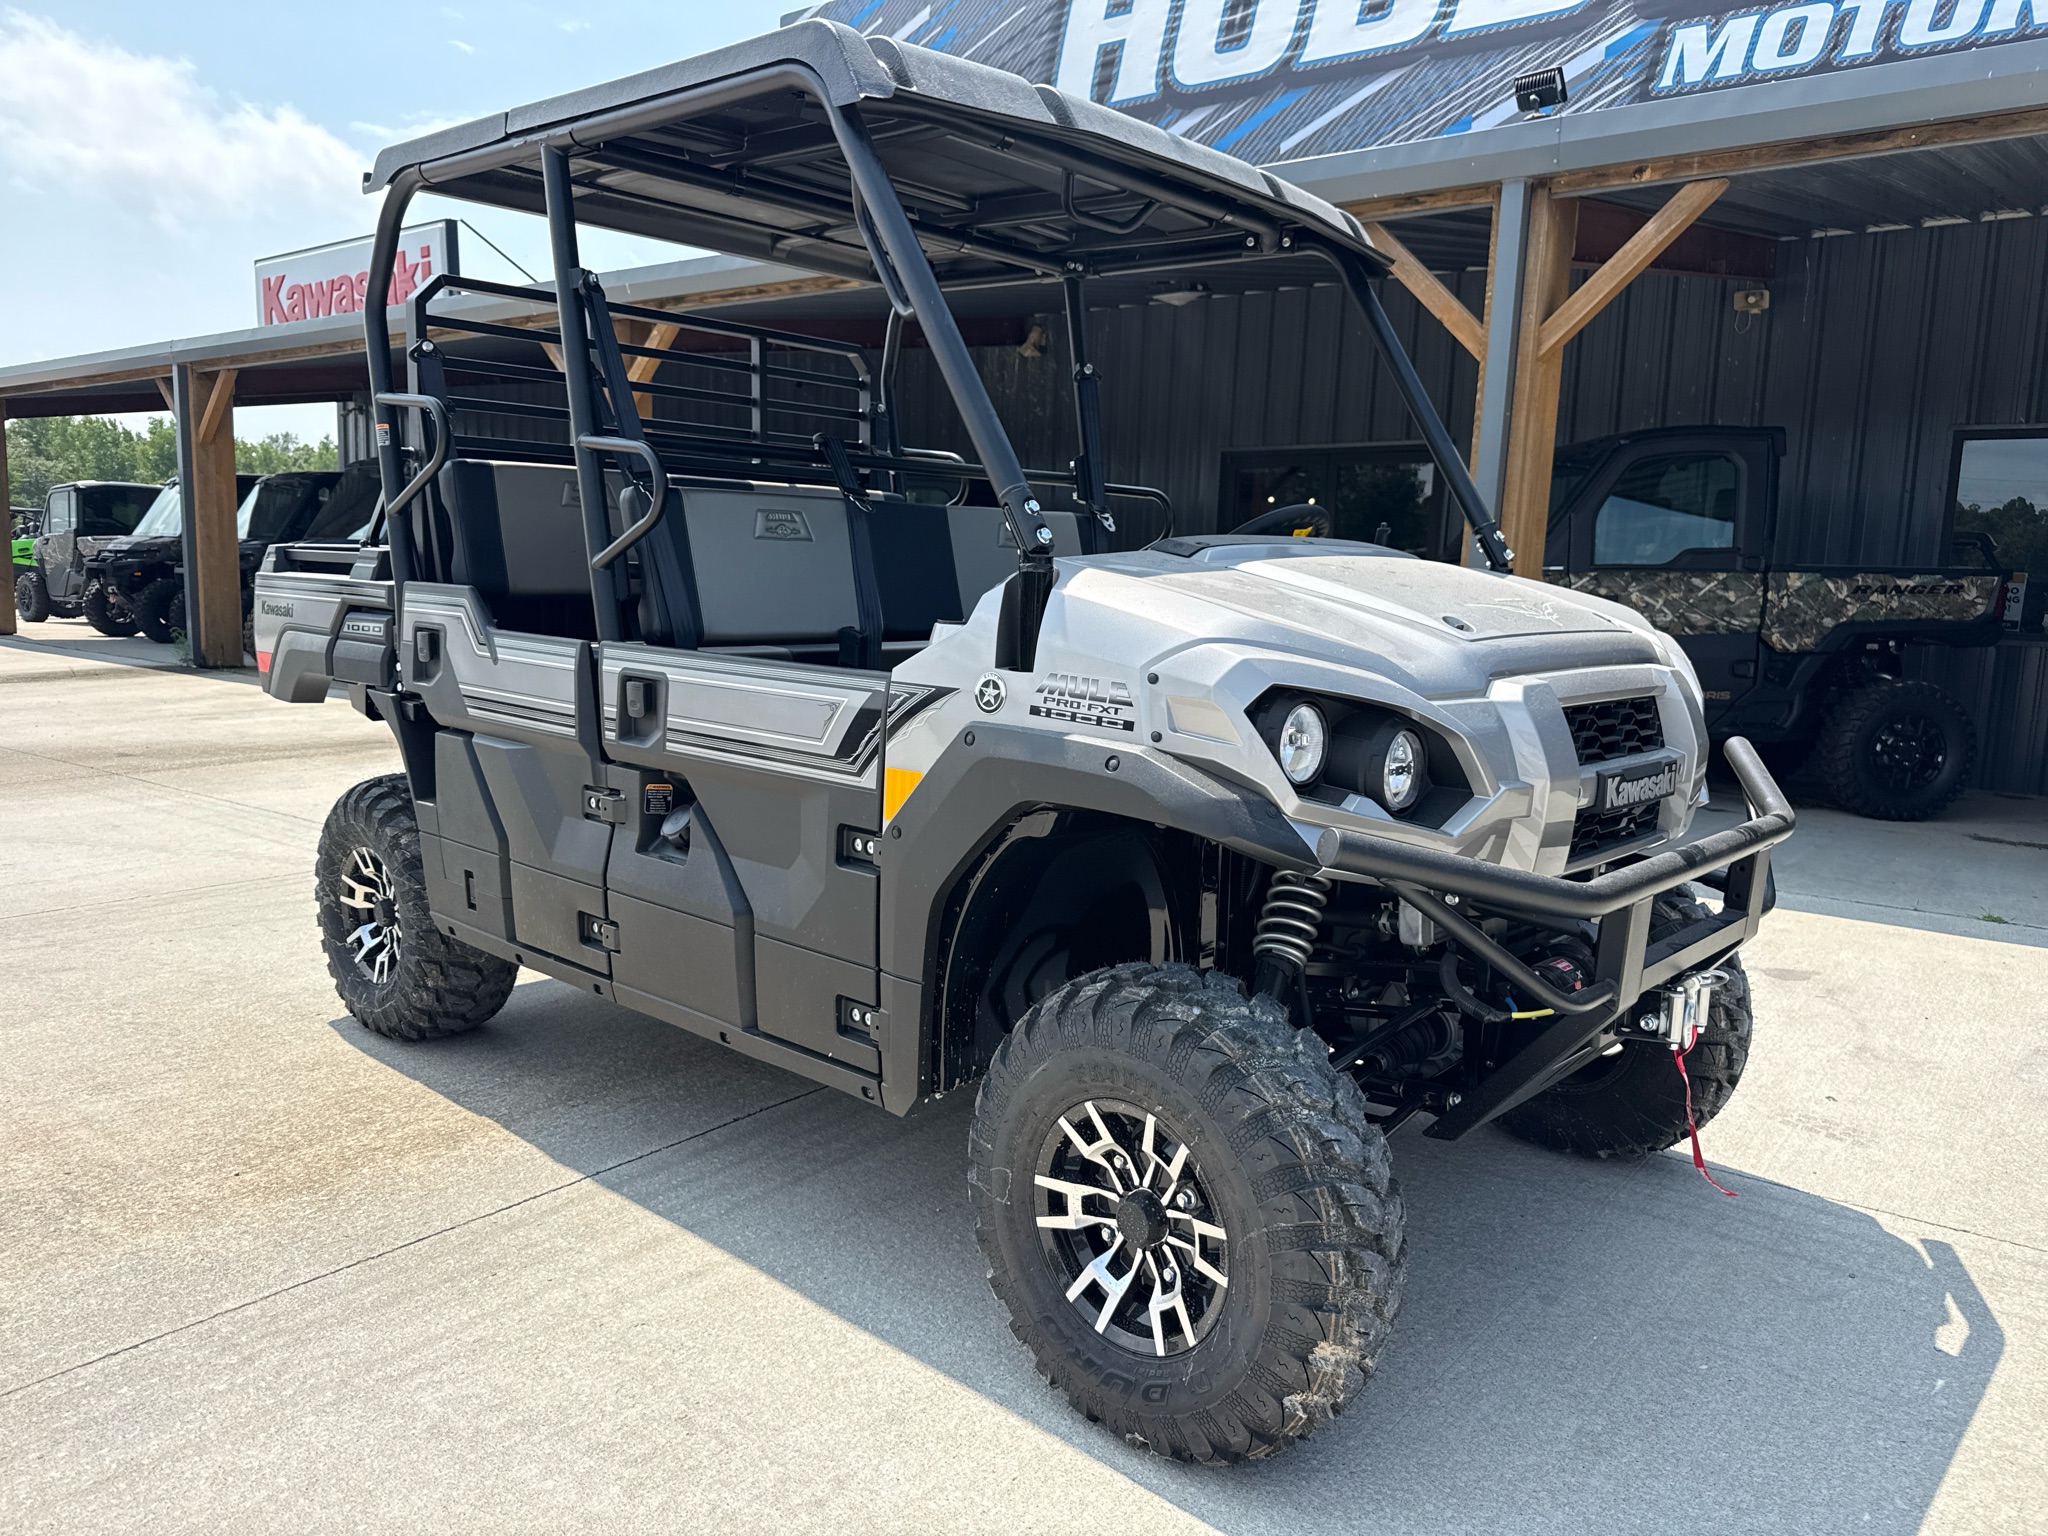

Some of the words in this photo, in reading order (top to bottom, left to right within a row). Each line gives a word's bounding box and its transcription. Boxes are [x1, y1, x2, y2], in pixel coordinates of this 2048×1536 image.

[1851, 584, 1965, 595] RANGER
[261, 599, 294, 618] Kawasaki
[346, 623, 382, 633] 1000
[1035, 672, 1134, 708] MULE
[1704, 691, 1731, 700] RIS
[1038, 707, 1124, 729] 1000
[1605, 763, 1676, 809] Kawasaki
[1035, 1313, 1173, 1407] DURO
